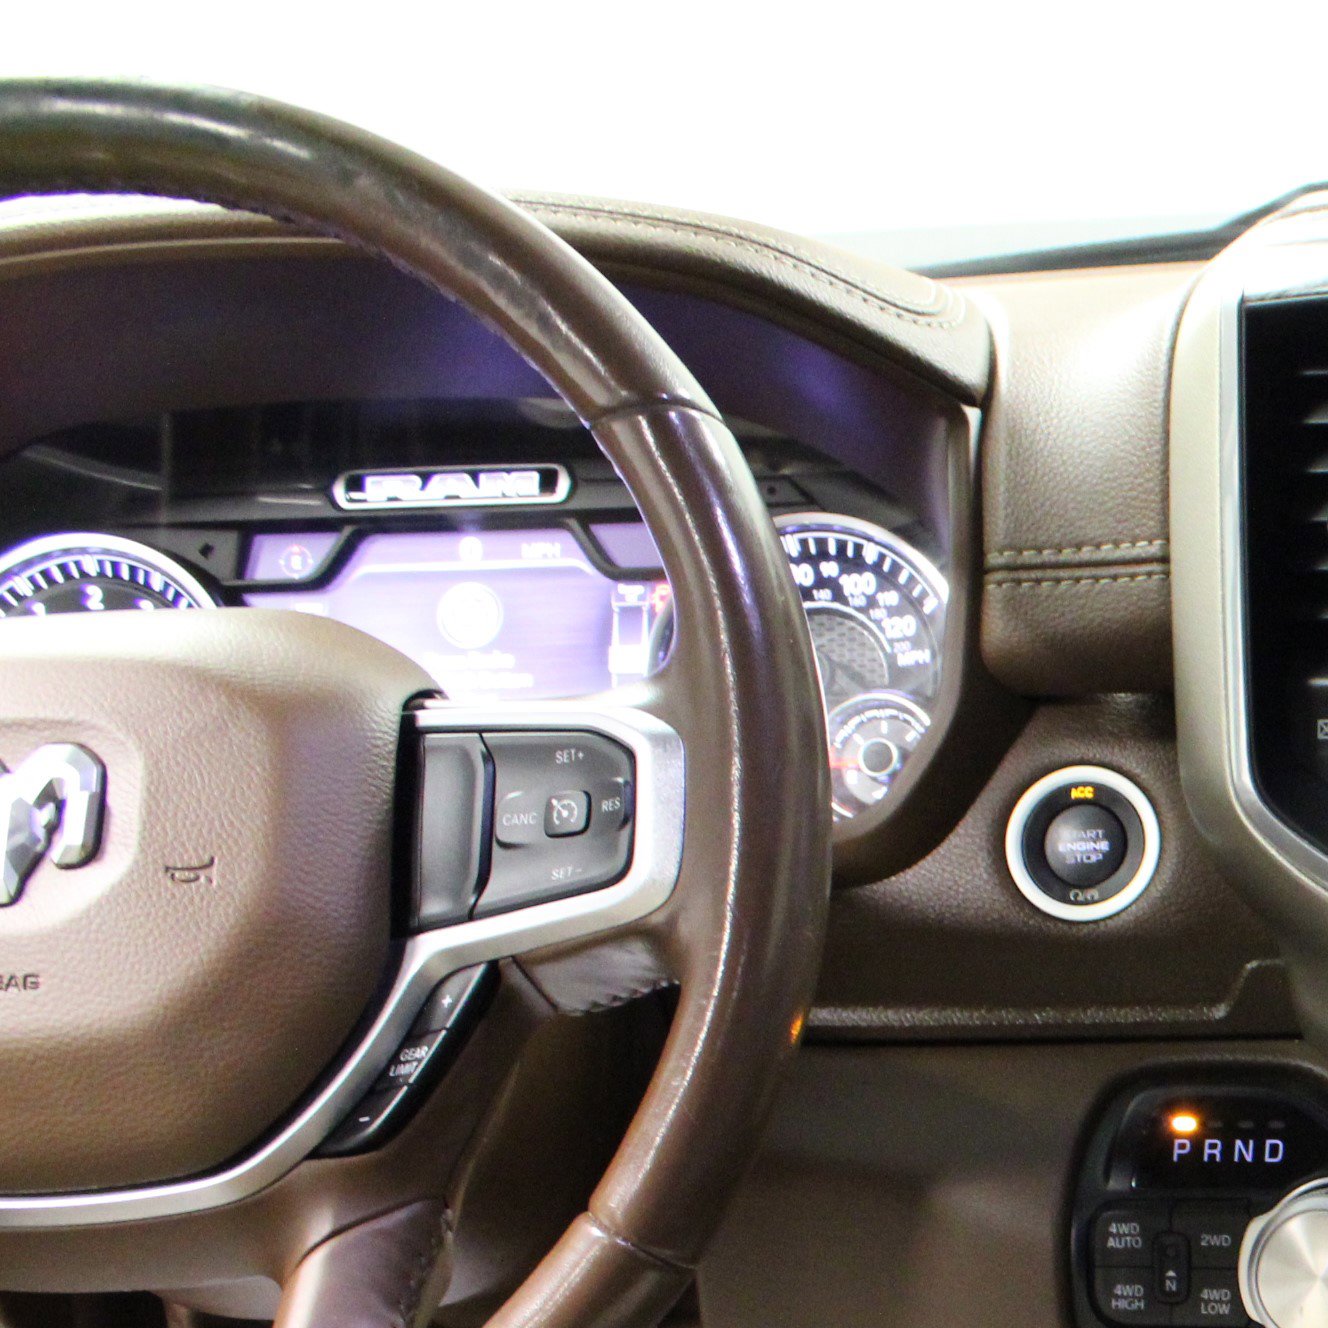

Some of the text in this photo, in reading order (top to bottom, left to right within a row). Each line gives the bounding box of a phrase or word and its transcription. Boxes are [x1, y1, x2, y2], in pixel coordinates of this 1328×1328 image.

[365, 471, 541, 502] RAM
[839, 572, 877, 596] 100
[882, 615, 916, 639] 120
[1071, 786, 1094, 800] ACC
[601, 797, 621, 813] RES
[502, 812, 537, 826] CANC
[1058, 840, 1110, 853] ENGINE
[400, 1045, 429, 1062] GEAR
[389, 1061, 419, 1077] LIMIT
[1108, 1222, 1140, 1235] 4WD
[1106, 1236, 1142, 1249] AUTO
[1200, 1234, 1232, 1247] 2WD
[1113, 1284, 1144, 1296] 4WD
[1200, 1288, 1232, 1301] 4WD
[1112, 1297, 1145, 1310] HIGH
[1200, 1302, 1231, 1315] LOW
